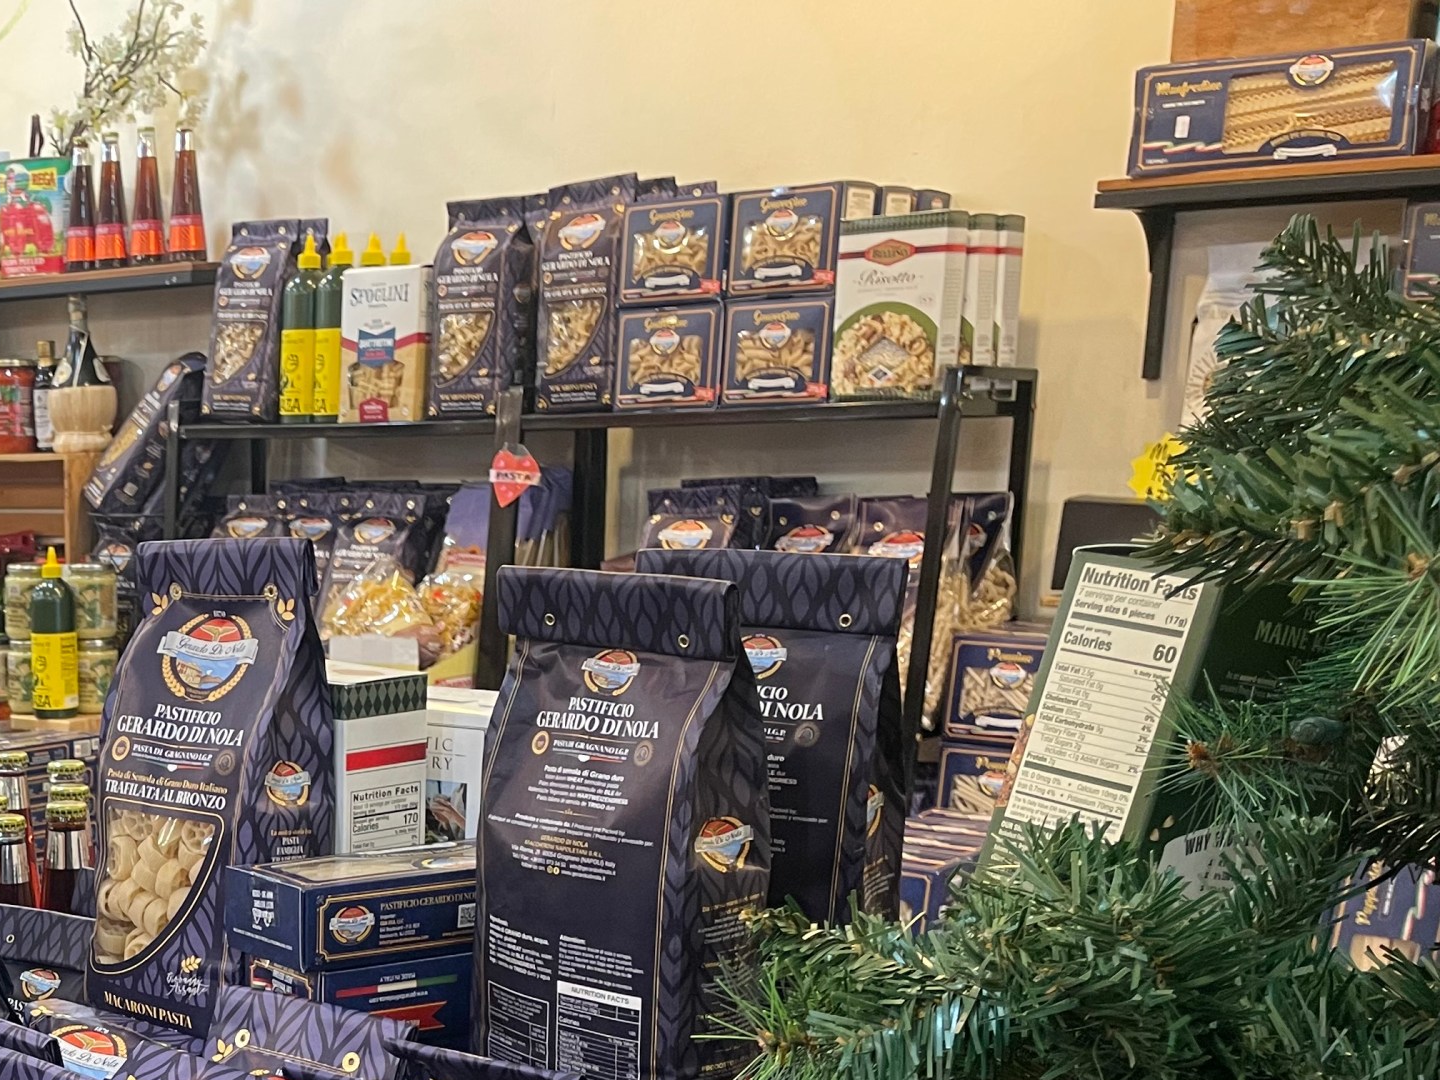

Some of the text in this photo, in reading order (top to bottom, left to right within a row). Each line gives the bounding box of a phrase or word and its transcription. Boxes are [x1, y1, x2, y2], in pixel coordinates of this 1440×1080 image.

[858, 270, 916, 285] Risotto
[496, 471, 532, 481] PASTA
[1082, 567, 1150, 593] Nutrition
[1085, 589, 1113, 603] servings
[1128, 597, 1162, 609] container
[1074, 599, 1102, 613] Serving
[1104, 604, 1120, 614] size
[1128, 608, 1155, 621] pieces
[1164, 616, 1188, 628] (17g)
[1254, 619, 1309, 650] MAINE
[1063, 631, 1177, 664] Calories 60
[155, 704, 221, 726] PASTIFICIO
[568, 697, 634, 718] PASTIFICIO
[780, 702, 824, 721] NOLA
[117, 715, 244, 746] GERARDO DI NOLA
[536, 710, 660, 740] GERARDO DI NOLA
[105, 779, 226, 810] TRAFILATA AL BRONZO
[353, 784, 419, 802] Nutrition Facts
[352, 813, 419, 834] Calories 170
[381, 899, 418, 911] PASTIFICIO
[418, 895, 454, 907] GERARDO
[571, 986, 630, 1006] NUTRITION FACTS
[104, 991, 193, 1029] MACARONI PASTA
